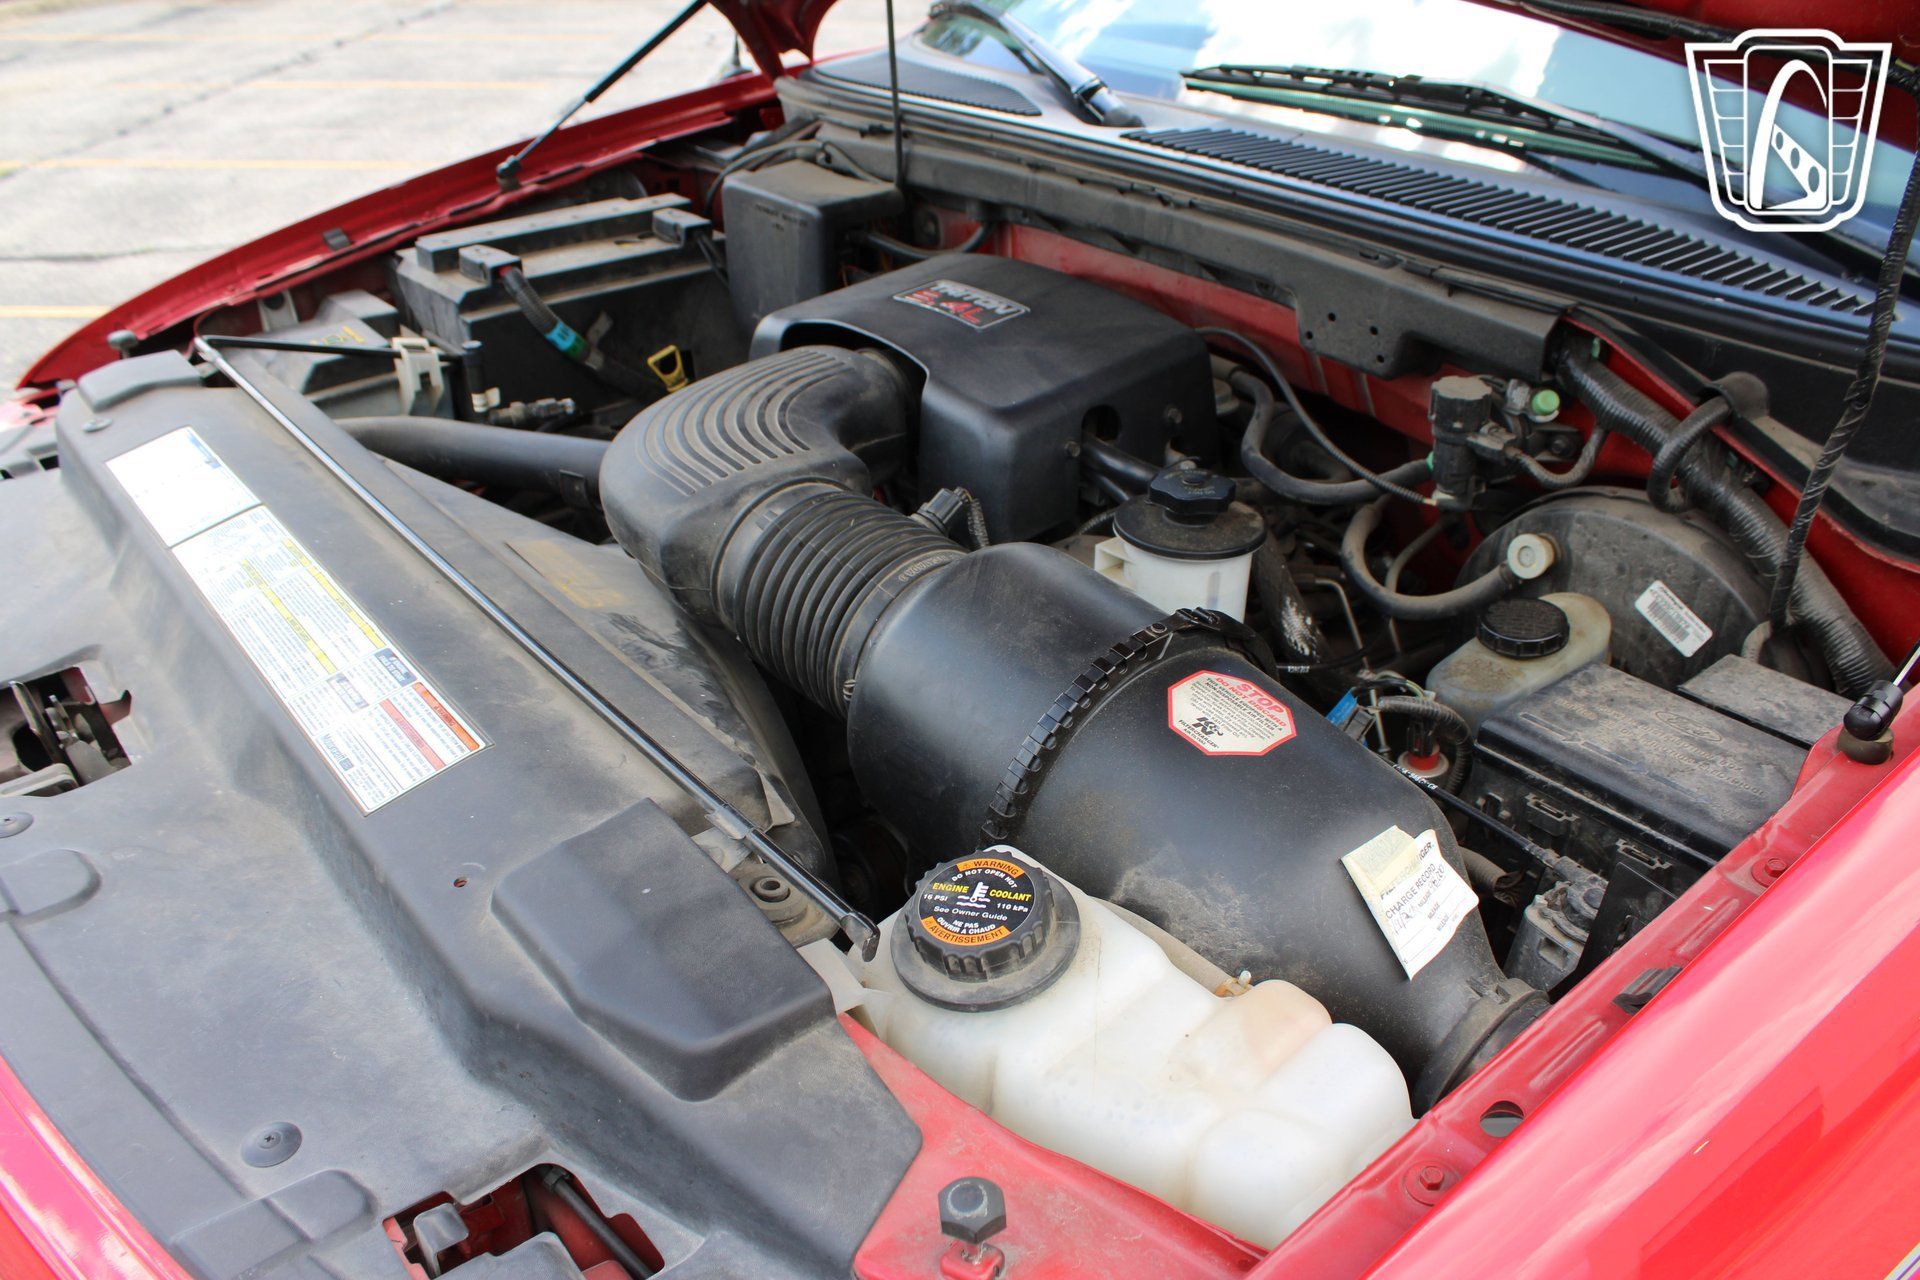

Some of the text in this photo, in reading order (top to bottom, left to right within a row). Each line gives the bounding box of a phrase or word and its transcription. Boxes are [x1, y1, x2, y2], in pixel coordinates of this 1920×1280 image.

[1215, 677, 1286, 726] DO NOT DISCARD
[1236, 683, 1284, 714] STOP
[951, 873, 963, 882] DO
[985, 869, 1005, 879] OPEN
[974, 860, 1019, 875] WARNING
[932, 883, 1031, 902] ENGINE COOLANT
[1386, 863, 1436, 919] CHARGE RECORD
[951, 908, 980, 917] Owner
[982, 911, 1007, 921] Guide
[997, 902, 1029, 913] 110 kPa
[930, 925, 1003, 943] AVERTISSEMENT
[937, 917, 960, 933] OUVRIR
[969, 924, 996, 934] CHAUD
